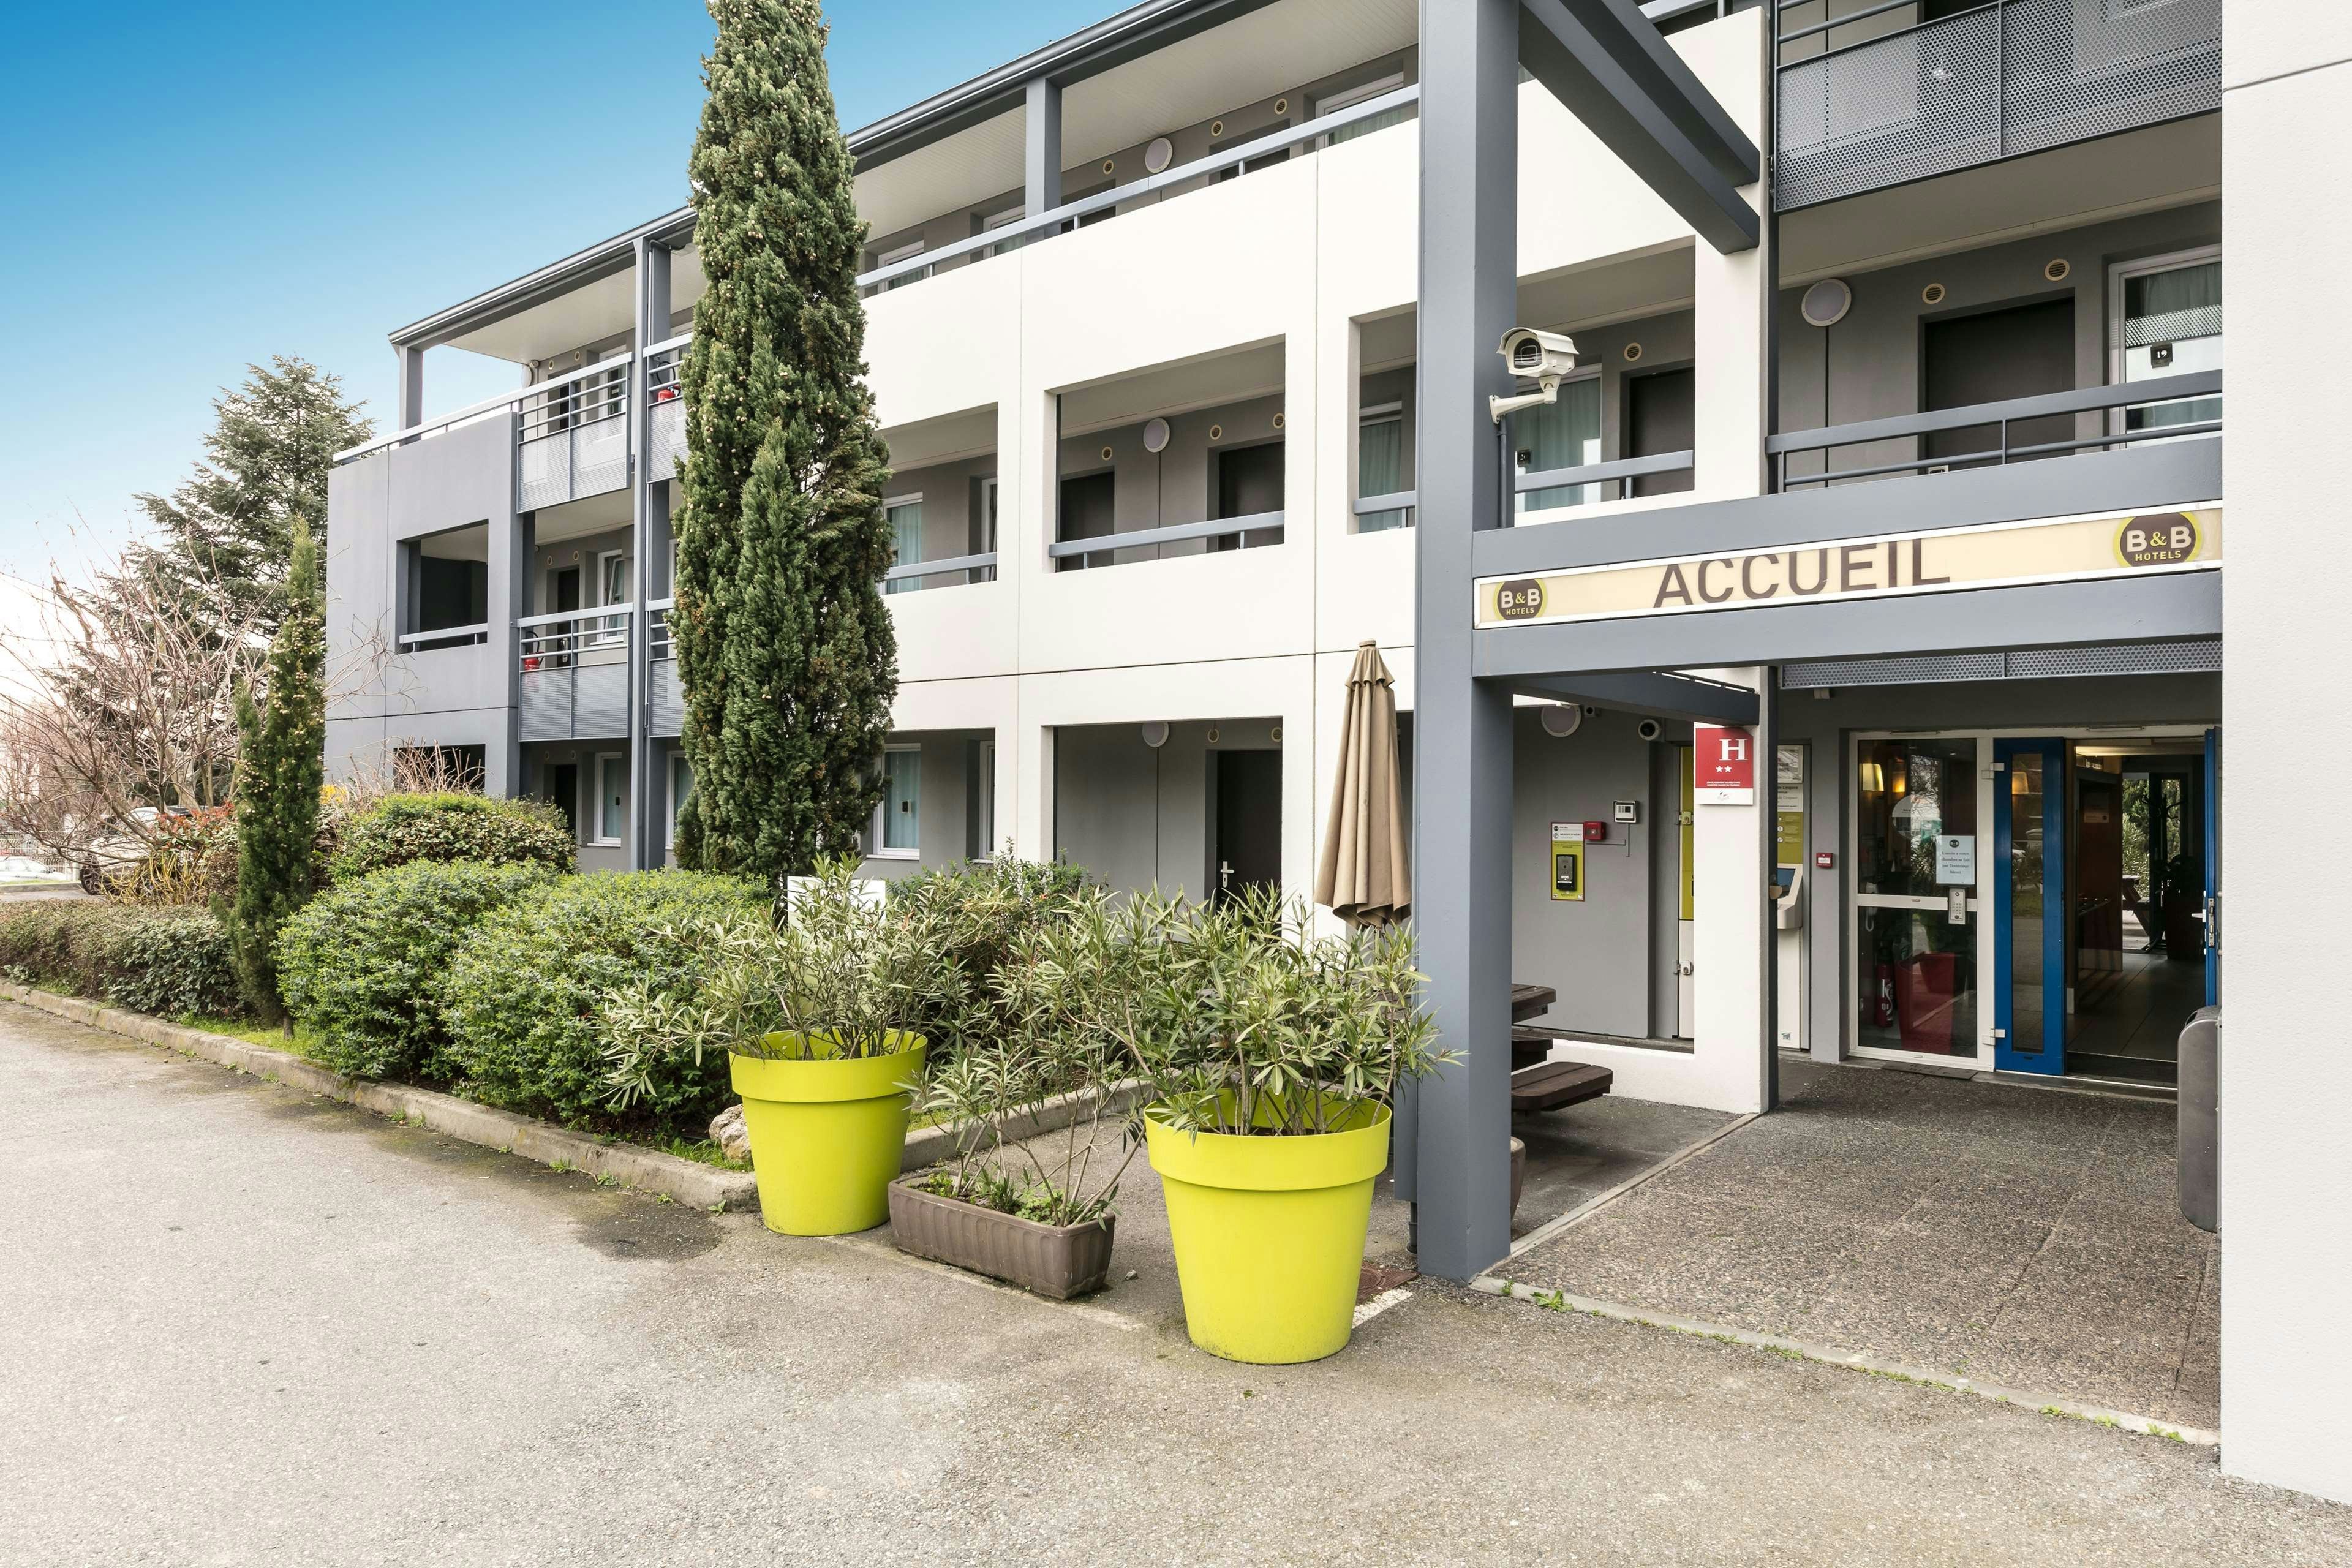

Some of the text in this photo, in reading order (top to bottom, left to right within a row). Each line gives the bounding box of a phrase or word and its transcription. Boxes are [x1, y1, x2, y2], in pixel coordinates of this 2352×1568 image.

[2127, 526, 2192, 552] B&B
[2135, 551, 2182, 561] HOTELS
[1653, 538, 1950, 608] ACCUEIL
[1501, 588, 1540, 608] B&B
[1719, 739, 1748, 760] H
